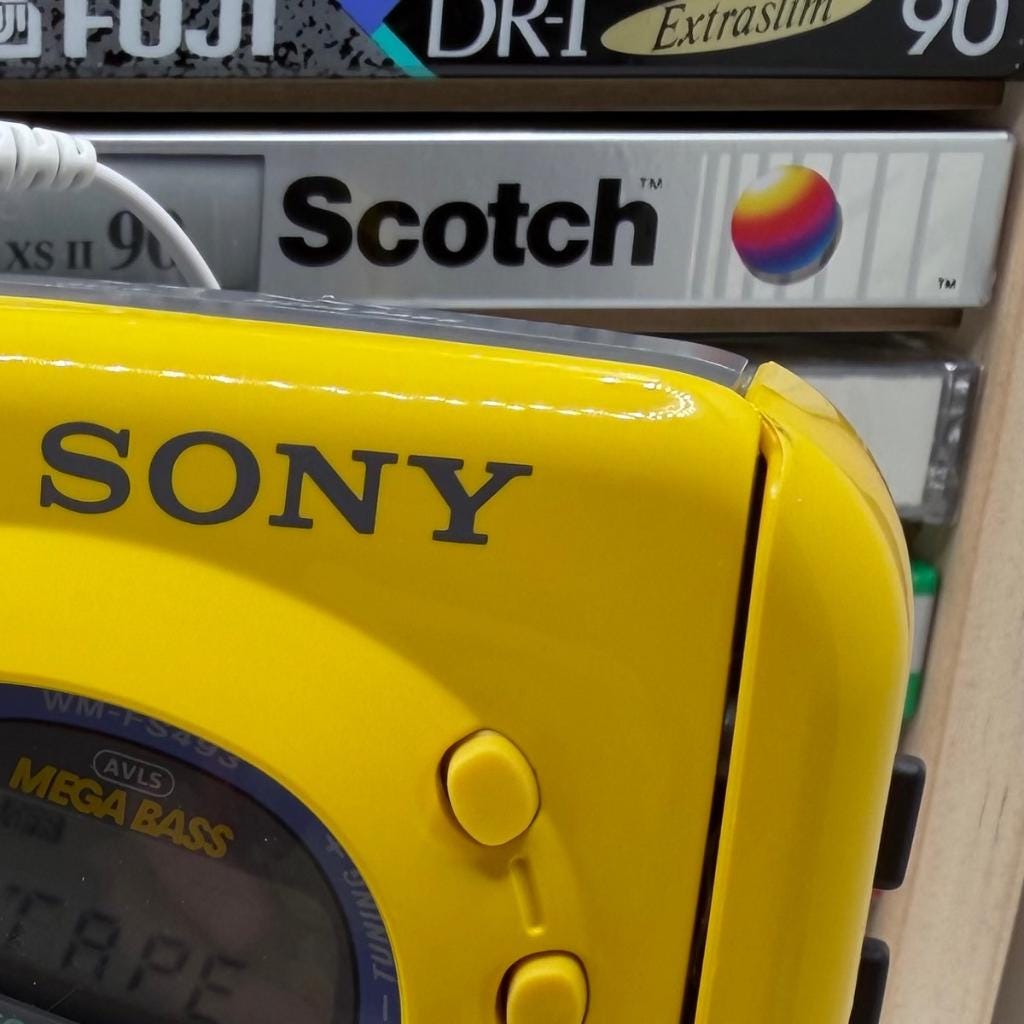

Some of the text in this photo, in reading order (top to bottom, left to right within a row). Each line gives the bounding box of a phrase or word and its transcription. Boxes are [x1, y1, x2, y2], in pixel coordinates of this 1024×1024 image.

[64, 0, 275, 58] FUJI
[902, 0, 1008, 57] 90
[278, 176, 658, 267] Scotch
[4, 240, 55, 271] XS
[39, 421, 534, 546] SONY
[103, 757, 164, 790] AVLS
[8, 757, 235, 859] MEGA BASS
